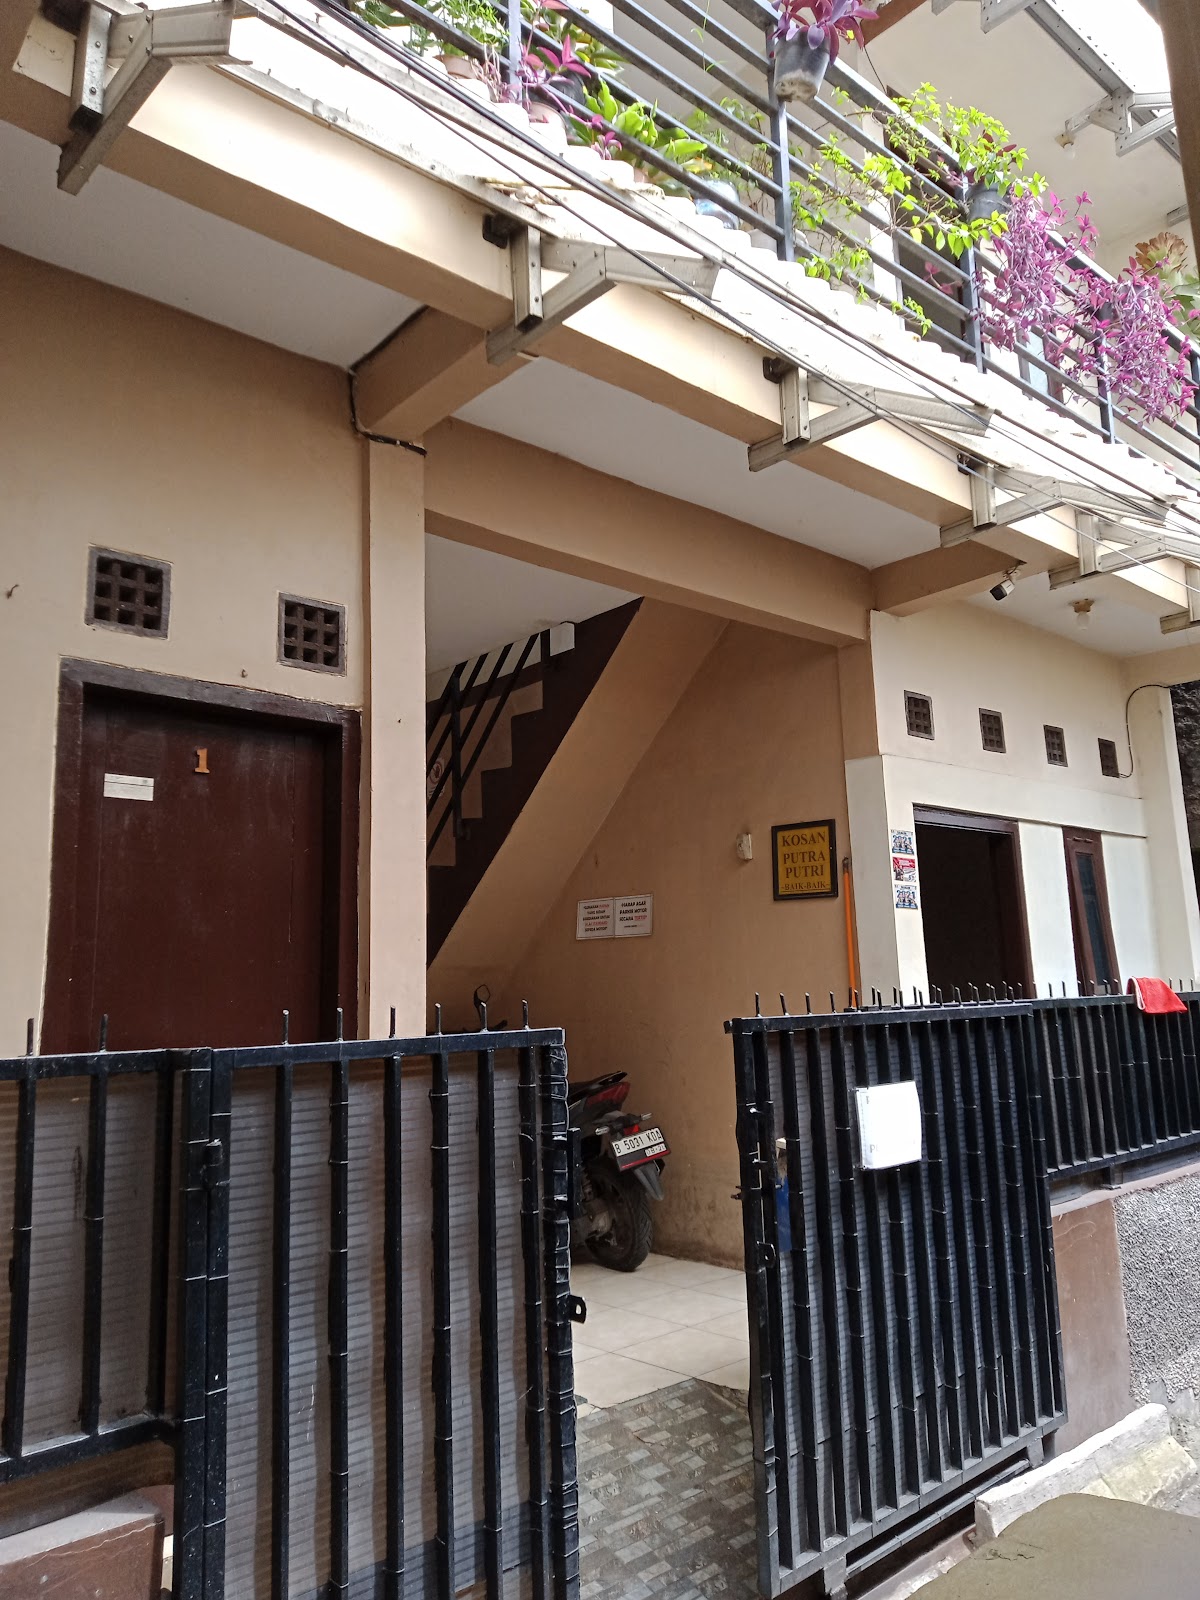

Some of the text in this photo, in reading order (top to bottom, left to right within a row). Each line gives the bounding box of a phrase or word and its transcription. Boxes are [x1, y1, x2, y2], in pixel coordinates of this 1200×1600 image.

[195, 748, 210, 773] 1
[782, 831, 826, 847] KOSAN
[783, 850, 826, 864] PUTRA
[785, 864, 824, 878] PUTRI
[896, 889, 916, 900] 2021
[615, 1144, 621, 1153] B
[623, 1136, 645, 1150] 5031
